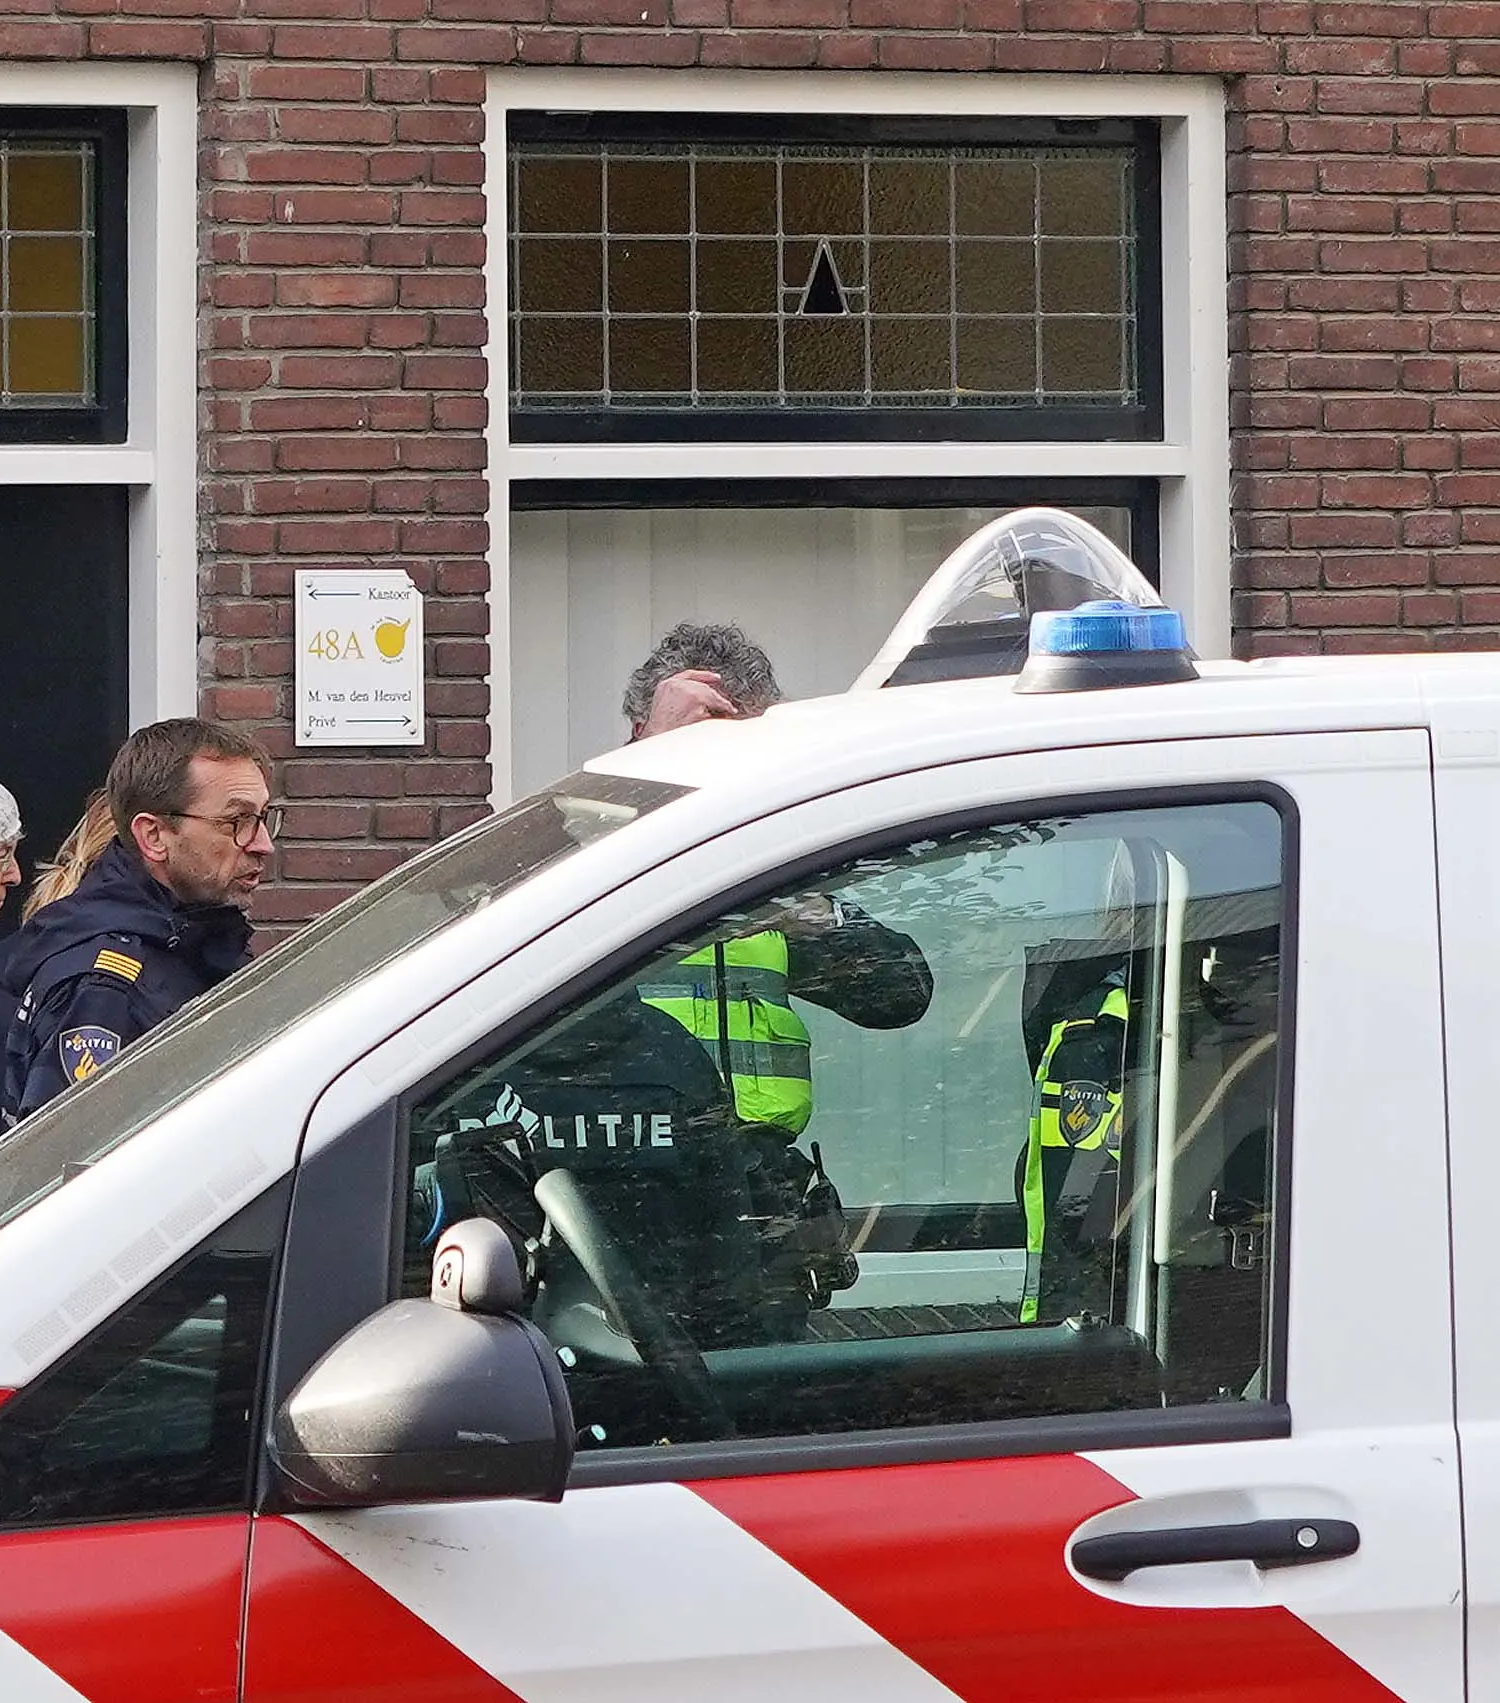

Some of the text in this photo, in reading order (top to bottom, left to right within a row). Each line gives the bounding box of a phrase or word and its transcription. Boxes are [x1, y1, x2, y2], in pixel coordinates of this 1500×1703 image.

[368, 588, 412, 600] Kantoor
[308, 629, 365, 660] 48A
[326, 693, 345, 702] van
[350, 690, 369, 702] den
[375, 690, 412, 702] Heuvel
[65, 1035, 113, 1051] POLITIE
